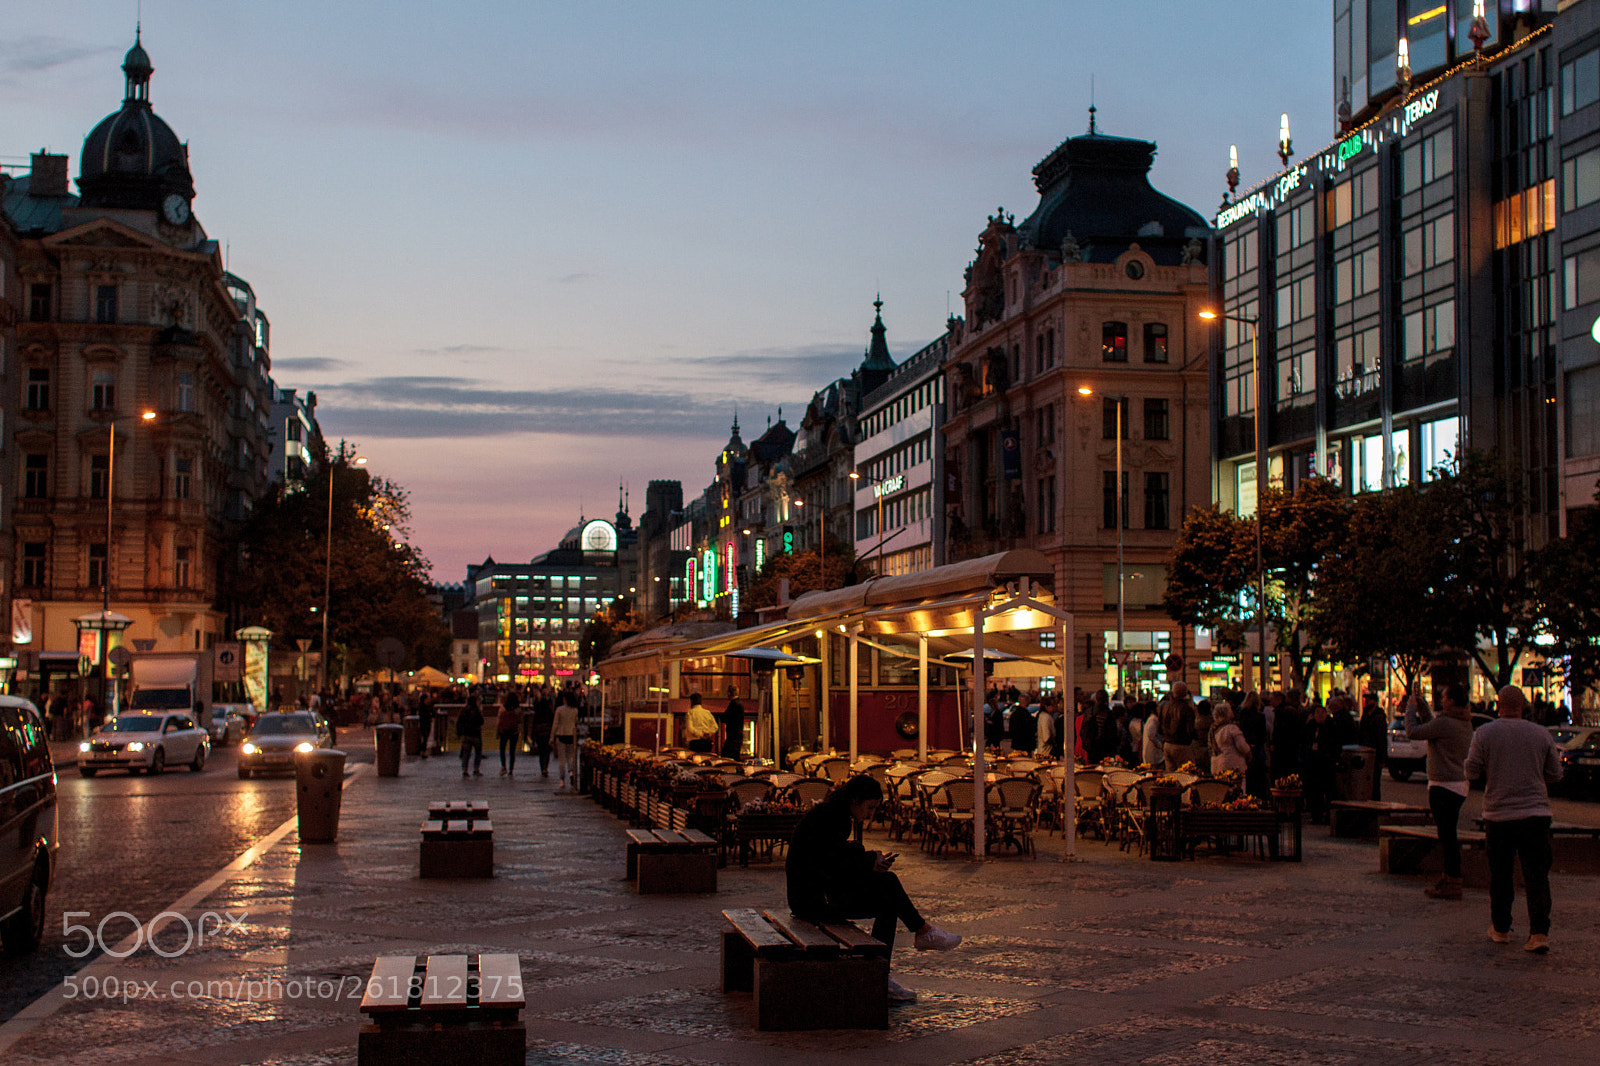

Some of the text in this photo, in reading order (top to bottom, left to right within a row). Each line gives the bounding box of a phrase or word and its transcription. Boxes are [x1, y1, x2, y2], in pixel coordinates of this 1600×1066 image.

[1404, 89, 1439, 126] TERASY
[1339, 134, 1362, 161] CLUB
[1217, 194, 1257, 230] RESTAURANT
